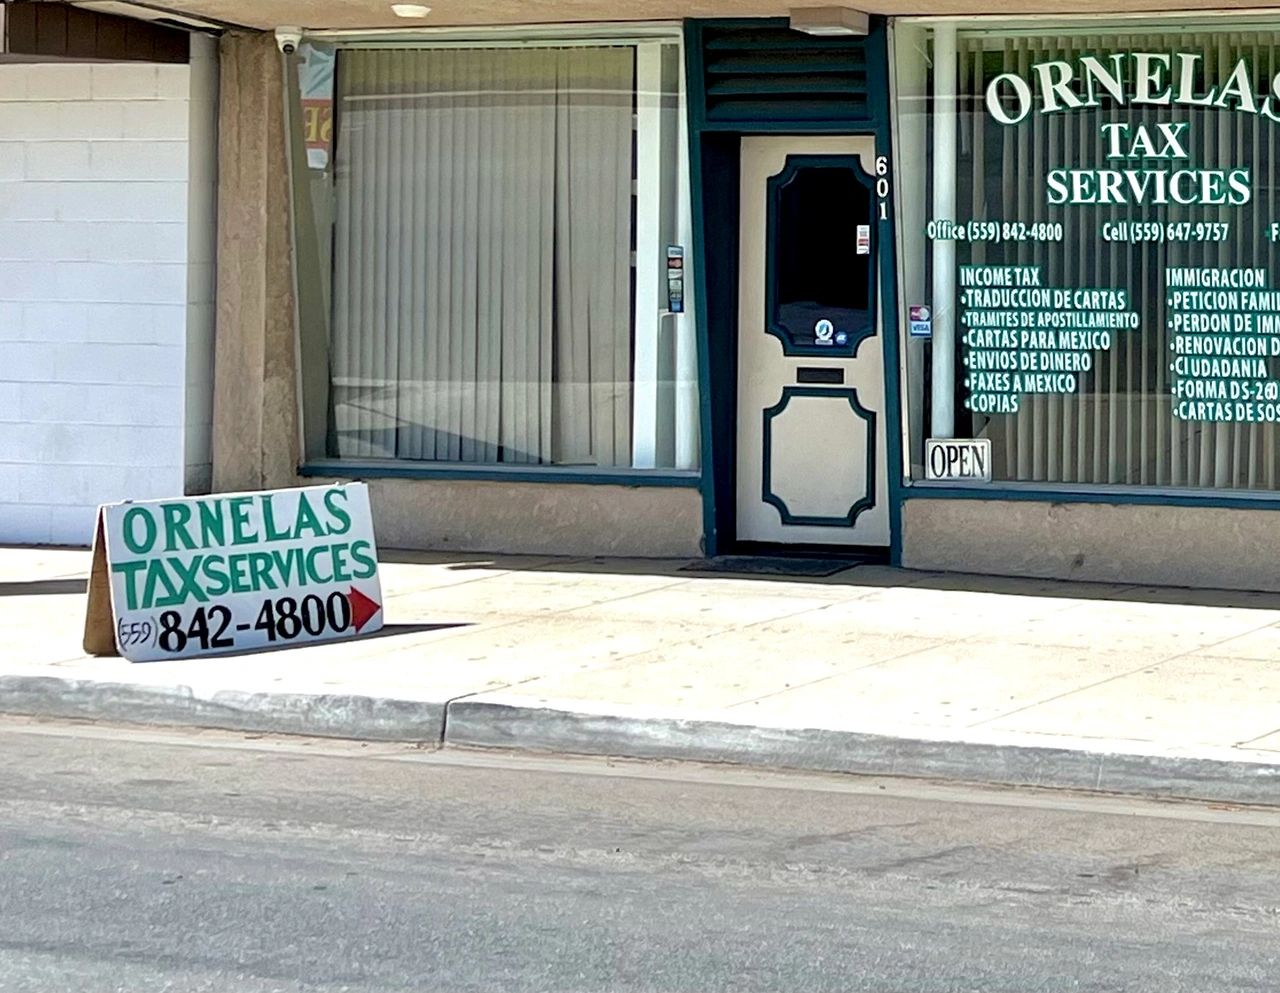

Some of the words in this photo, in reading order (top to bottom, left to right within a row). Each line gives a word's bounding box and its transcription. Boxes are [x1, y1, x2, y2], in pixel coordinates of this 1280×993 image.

[1101, 123, 1187, 158] TAX
[1046, 169, 1251, 206] SERVICES
[927, 220, 965, 240] Office
[967, 221, 1000, 244] (559)
[1002, 222, 1063, 241] 842-4800
[1102, 222, 1128, 241] Cell
[1130, 222, 1164, 244] (559)
[1166, 222, 1229, 241] 647-9757
[960, 268, 1012, 286] INCOME
[1014, 268, 1040, 286] TAX
[1166, 268, 1265, 287] IMMIGRACION
[966, 289, 1051, 307] TRADUCCION
[1054, 290, 1071, 308] DE
[1074, 291, 1125, 310] CARTAS
[1173, 291, 1238, 310] PETICION
[966, 311, 1019, 327] TRAMITES
[1021, 312, 1035, 327] DE
[1037, 312, 1139, 328] APOSTILLAMIENTO
[1174, 314, 1231, 332] PERDON
[1234, 314, 1252, 333] DE
[968, 329, 1018, 348] CARTAS
[1021, 330, 1056, 349] PARA
[1058, 331, 1111, 350] MEXICO
[1175, 336, 1267, 355] RENOVACION
[968, 351, 1017, 370] ENVIOS
[1020, 352, 1038, 371] DE
[1040, 352, 1092, 371] DINERO
[1175, 357, 1268, 378] CIUDADANIA
[970, 372, 1010, 391] FAXES
[1013, 373, 1022, 392] A
[1025, 374, 1076, 392] MEXICO
[1176, 380, 1227, 399] FORMA
[970, 394, 1018, 412] COPIAS
[1178, 402, 1232, 421] CARTAS
[1235, 403, 1254, 422] DE
[930, 444, 985, 478] OPEN
[122, 488, 352, 555] ORNELAS
[117, 614, 158, 652] (559)
[158, 591, 350, 653] 842-4800
